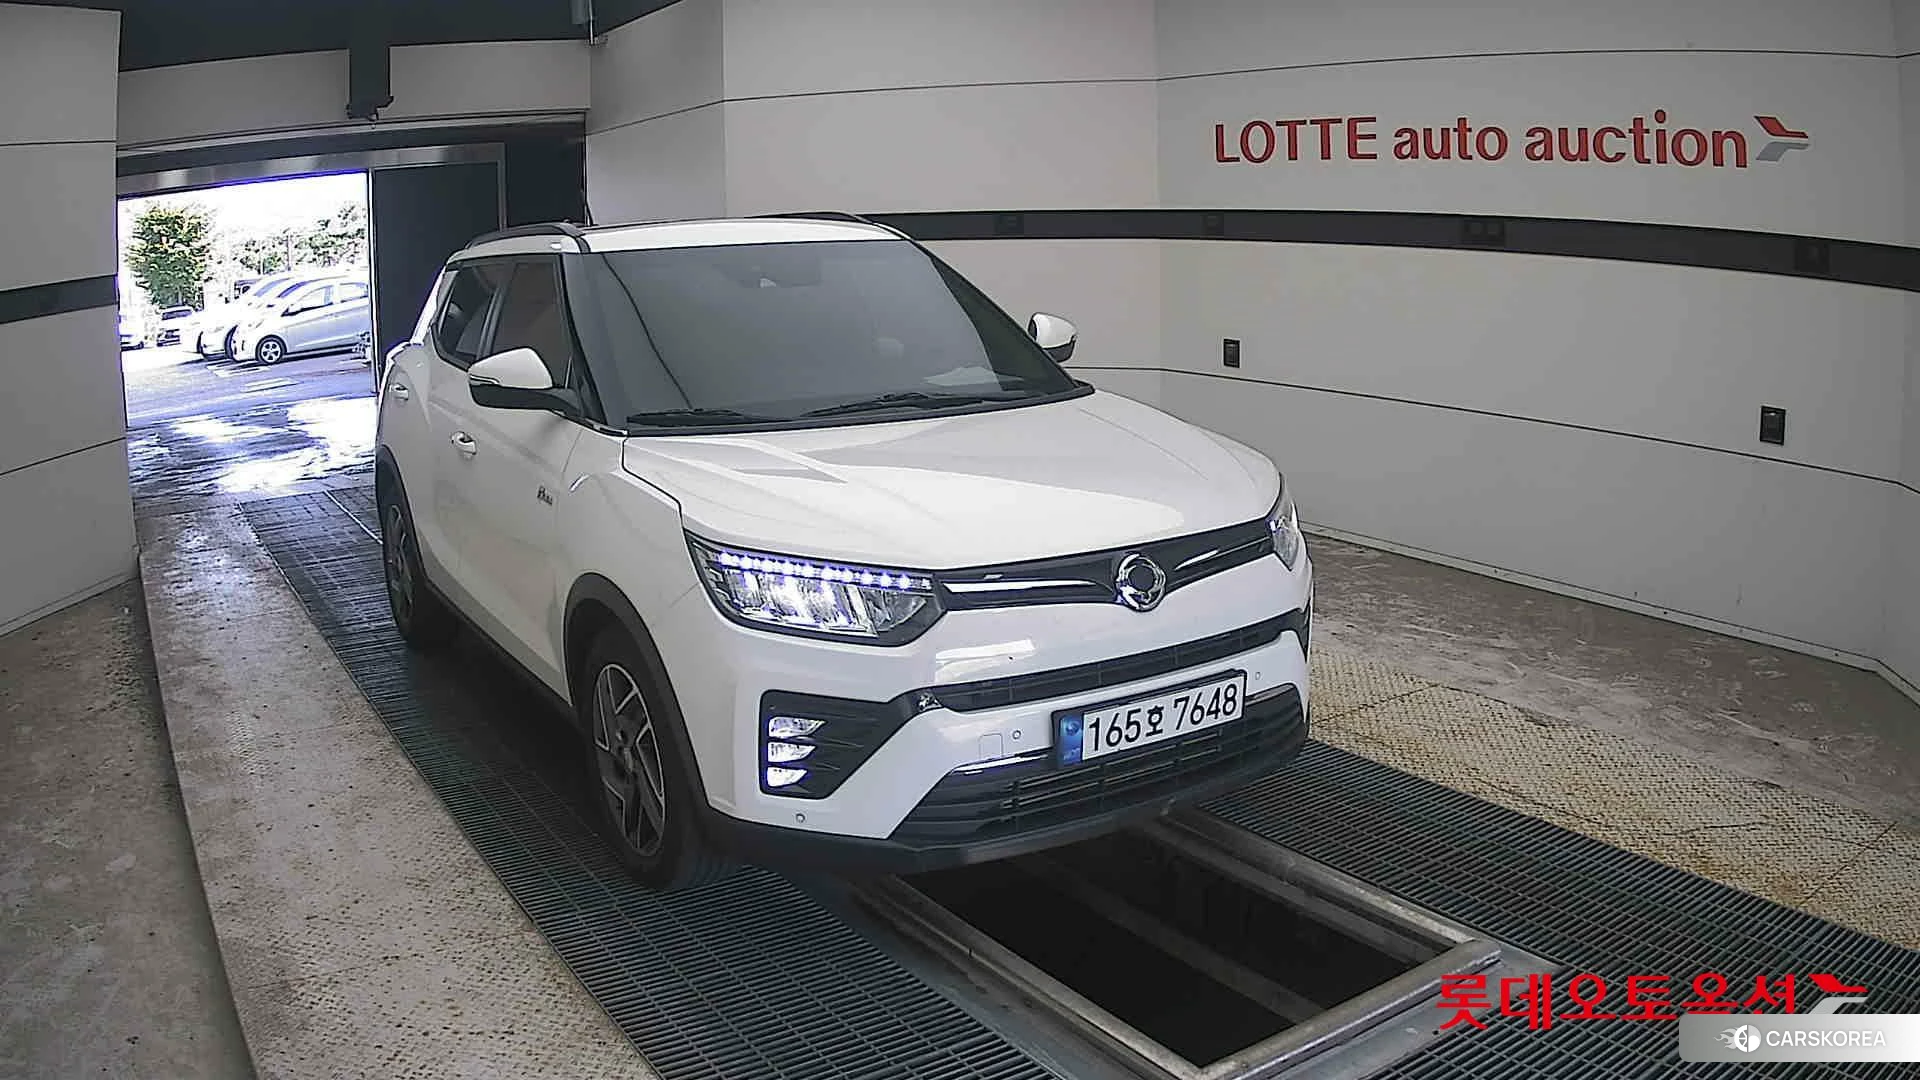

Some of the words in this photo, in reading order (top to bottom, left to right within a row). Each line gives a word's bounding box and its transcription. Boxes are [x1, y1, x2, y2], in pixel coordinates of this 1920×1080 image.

[1215, 116, 1378, 164] LOTTE
[1392, 117, 1508, 161] auto
[1524, 109, 1748, 168] auction
[1088, 705, 1165, 751] 165호
[1173, 683, 1238, 731] 7648
